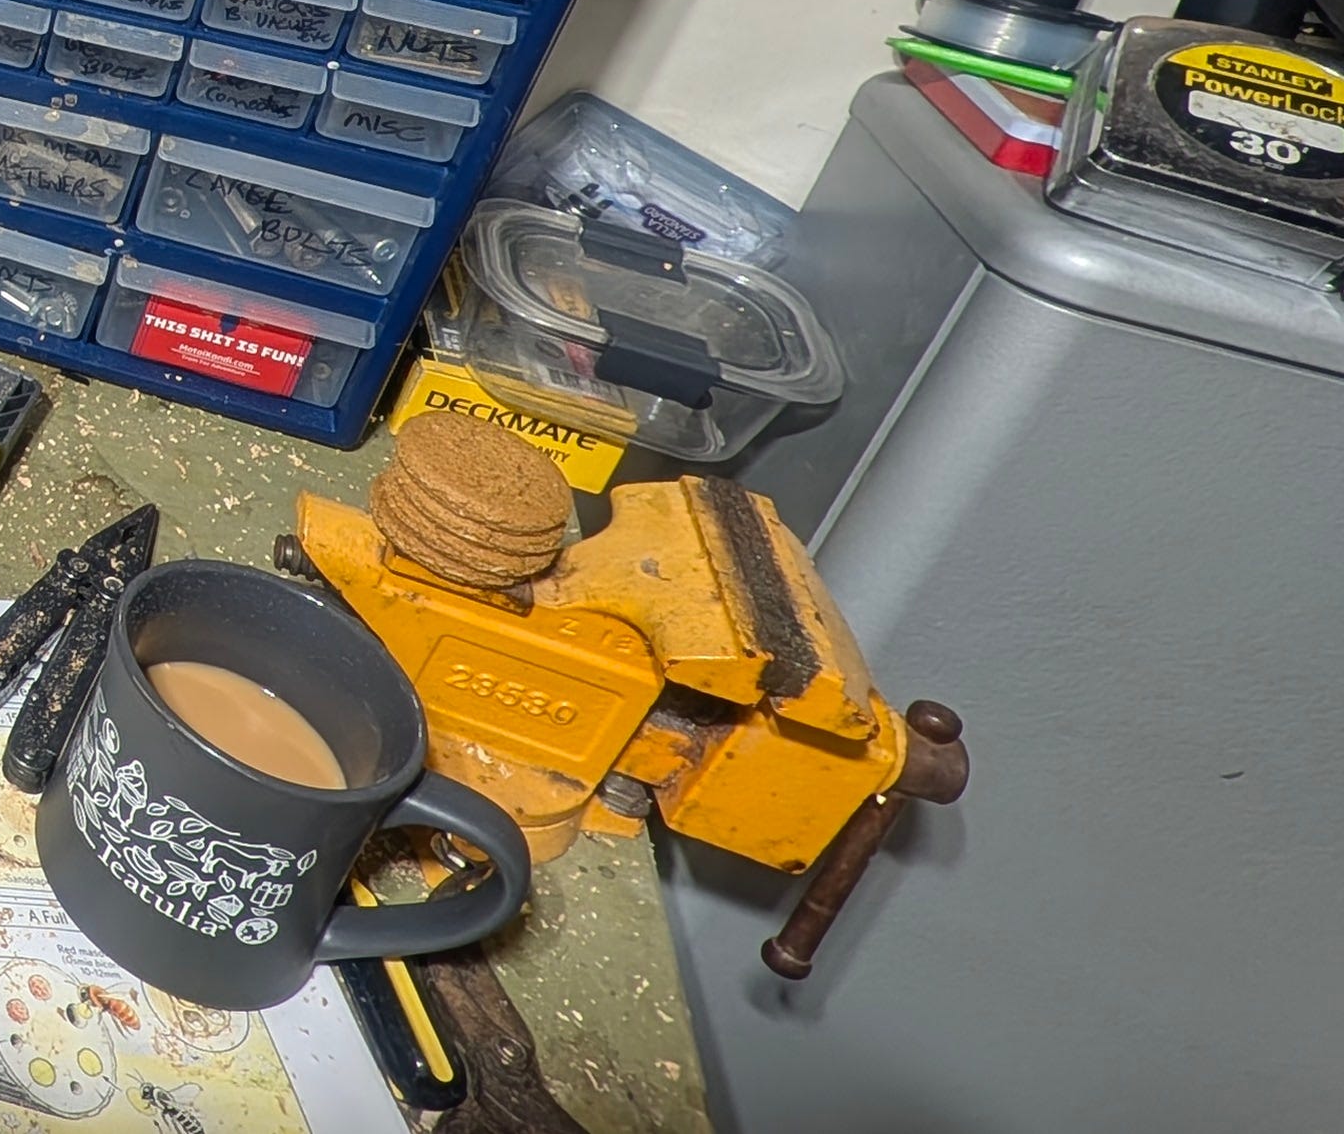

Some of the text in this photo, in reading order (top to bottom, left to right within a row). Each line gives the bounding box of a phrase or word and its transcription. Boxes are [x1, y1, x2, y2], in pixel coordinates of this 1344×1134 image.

[377, 24, 478, 63] NUTS
[1216, 57, 1324, 90] STANLEY
[343, 112, 427, 142] MISC
[184, 173, 293, 216] LARGE
[260, 218, 373, 268] BOLTS
[144, 314, 305, 368] THIS SHIT IS FUN!
[425, 389, 601, 452] DECKMATE
[534, 445, 571, 464] ANTY
[6, 874, 48, 887] Sandpap
[97, 833, 223, 938] Teatulia
[29, 909, 40, 923] A
[44, 911, 69, 925] Full
[57, 944, 77, 956] Red
